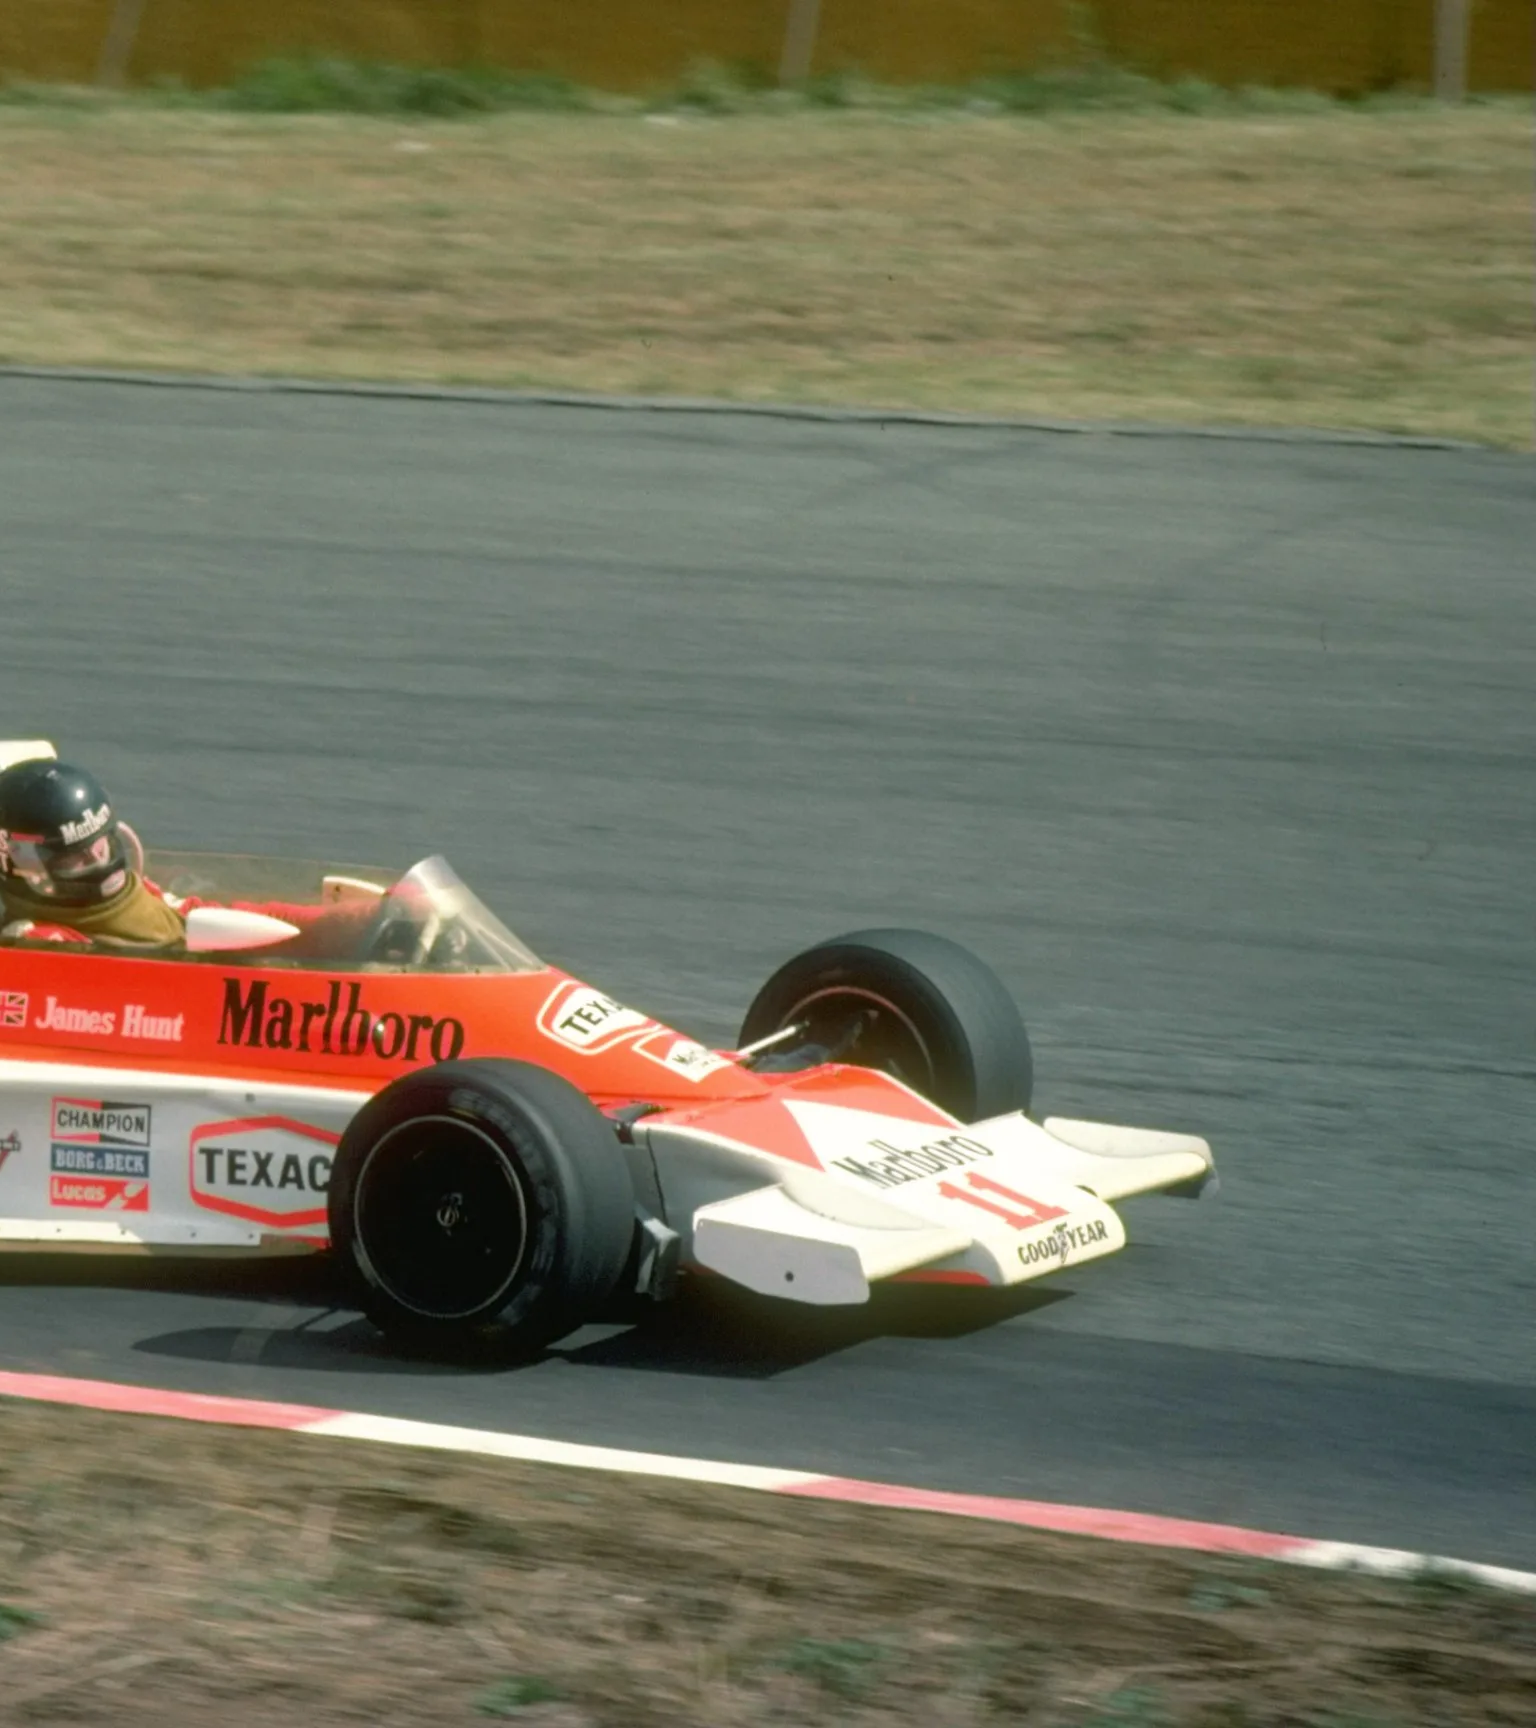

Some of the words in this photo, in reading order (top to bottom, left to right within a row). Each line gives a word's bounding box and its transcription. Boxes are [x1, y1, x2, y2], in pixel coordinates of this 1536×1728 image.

[59, 803, 111, 845] Marlbor
[35, 996, 114, 1035] James
[121, 1004, 184, 1042] Hunt
[217, 978, 465, 1064] Marlboro
[559, 997, 624, 1035] TEXA
[56, 1109, 146, 1133] CHAMPION
[199, 1147, 332, 1193] TEXAC
[830, 1136, 995, 1190] Marlboro
[936, 1170, 1071, 1231] 11
